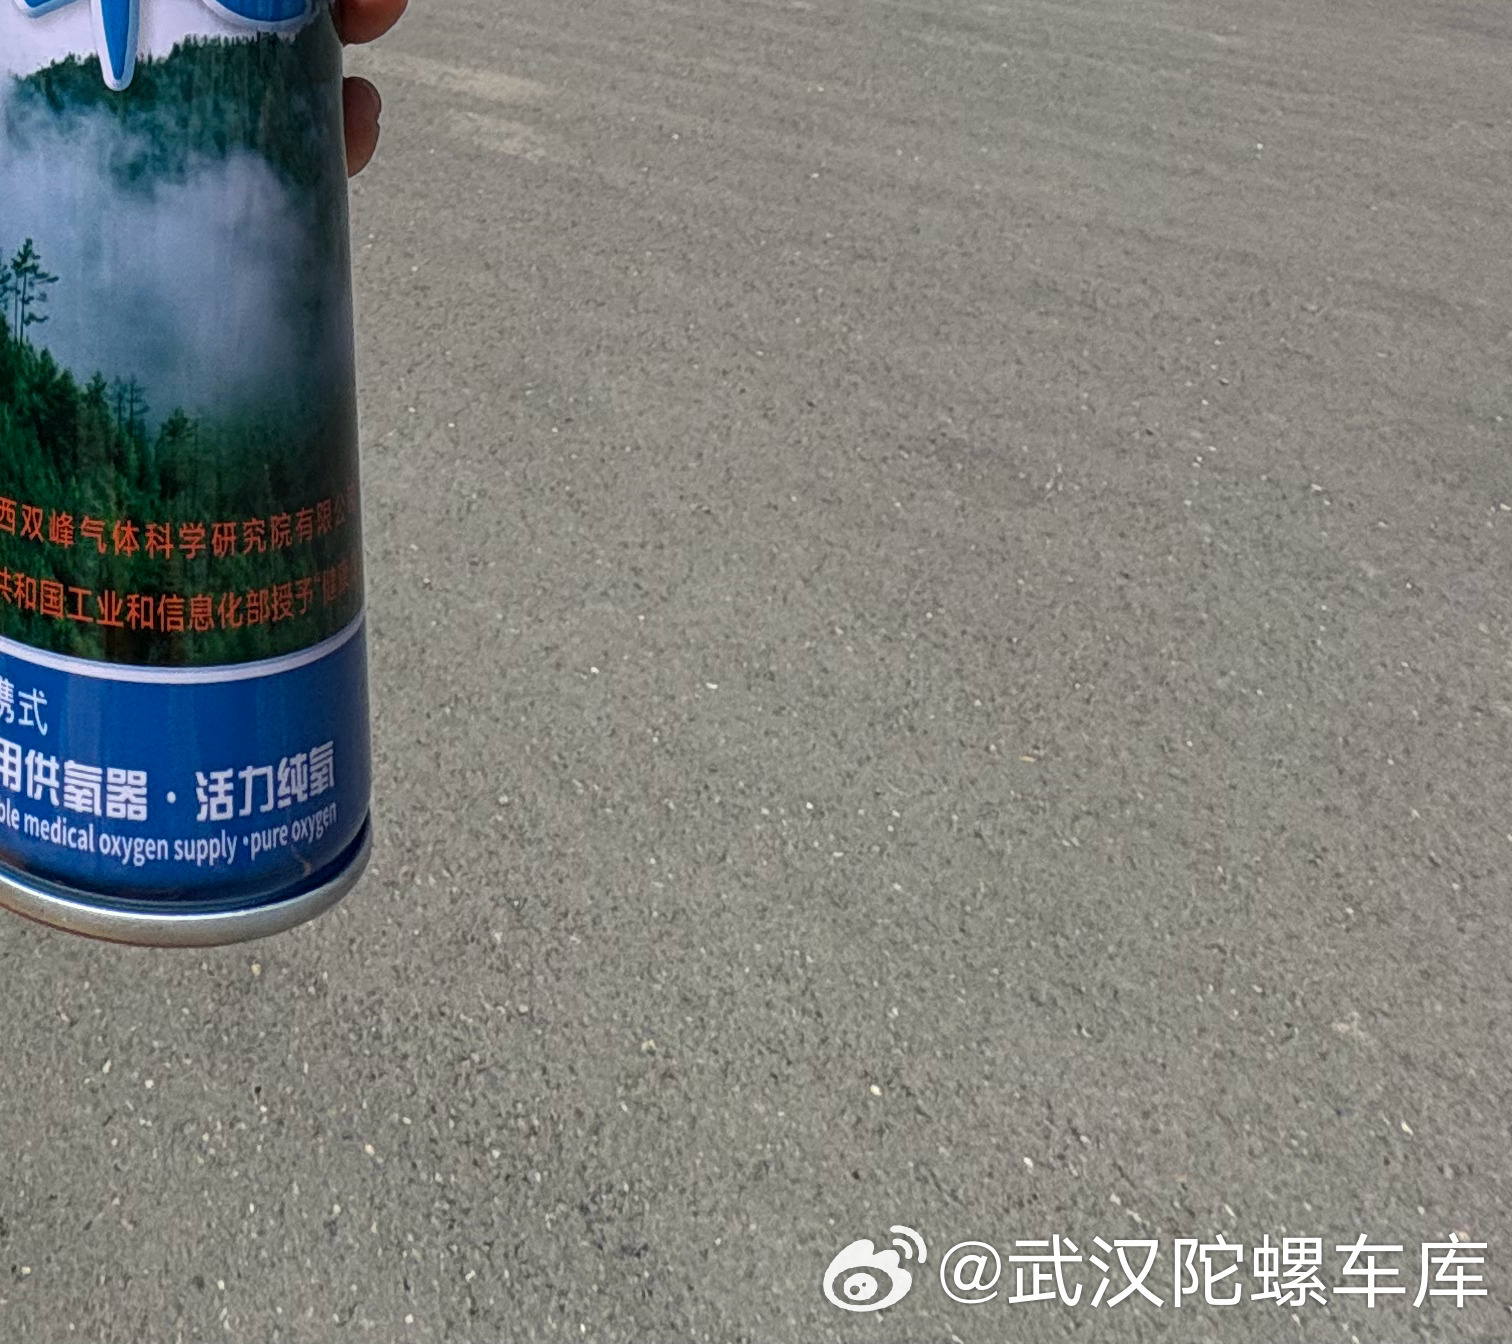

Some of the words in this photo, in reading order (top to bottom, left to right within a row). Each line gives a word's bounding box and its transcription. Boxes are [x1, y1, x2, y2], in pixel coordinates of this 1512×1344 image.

[23, 812, 95, 853] medical
[99, 833, 168, 867] oxygen
[174, 829, 238, 867] supply
[291, 801, 337, 844] oxygen
